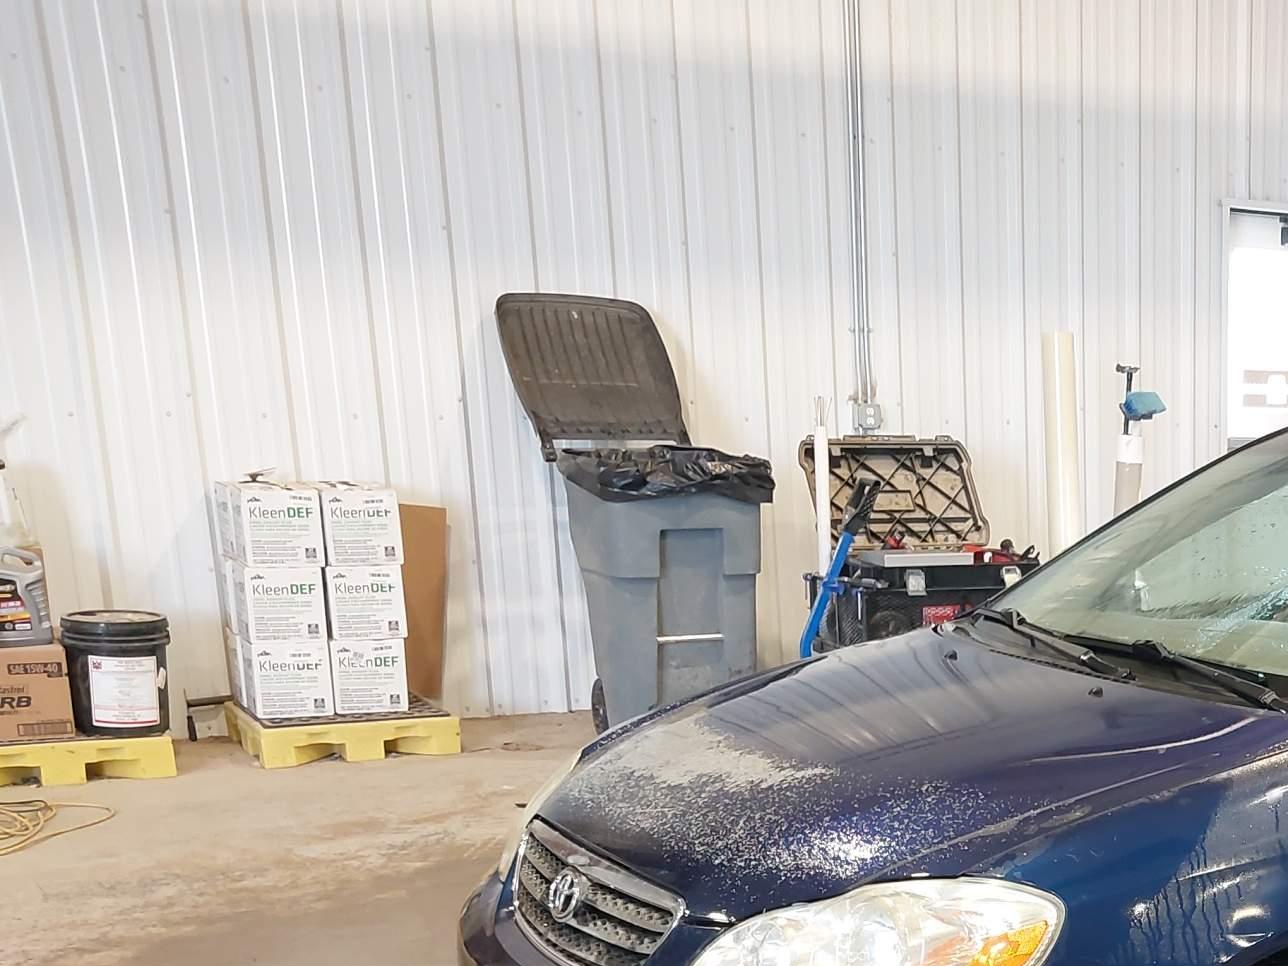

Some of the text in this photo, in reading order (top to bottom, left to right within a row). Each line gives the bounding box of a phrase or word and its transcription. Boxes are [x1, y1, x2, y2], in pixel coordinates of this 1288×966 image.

[248, 506, 313, 519] KleenDEF
[252, 583, 317, 596] KleenDEF
[334, 582, 396, 594] KleenDEF
[9, 662, 58, 674] SAE 15W-40
[0, 695, 32, 709] RB
